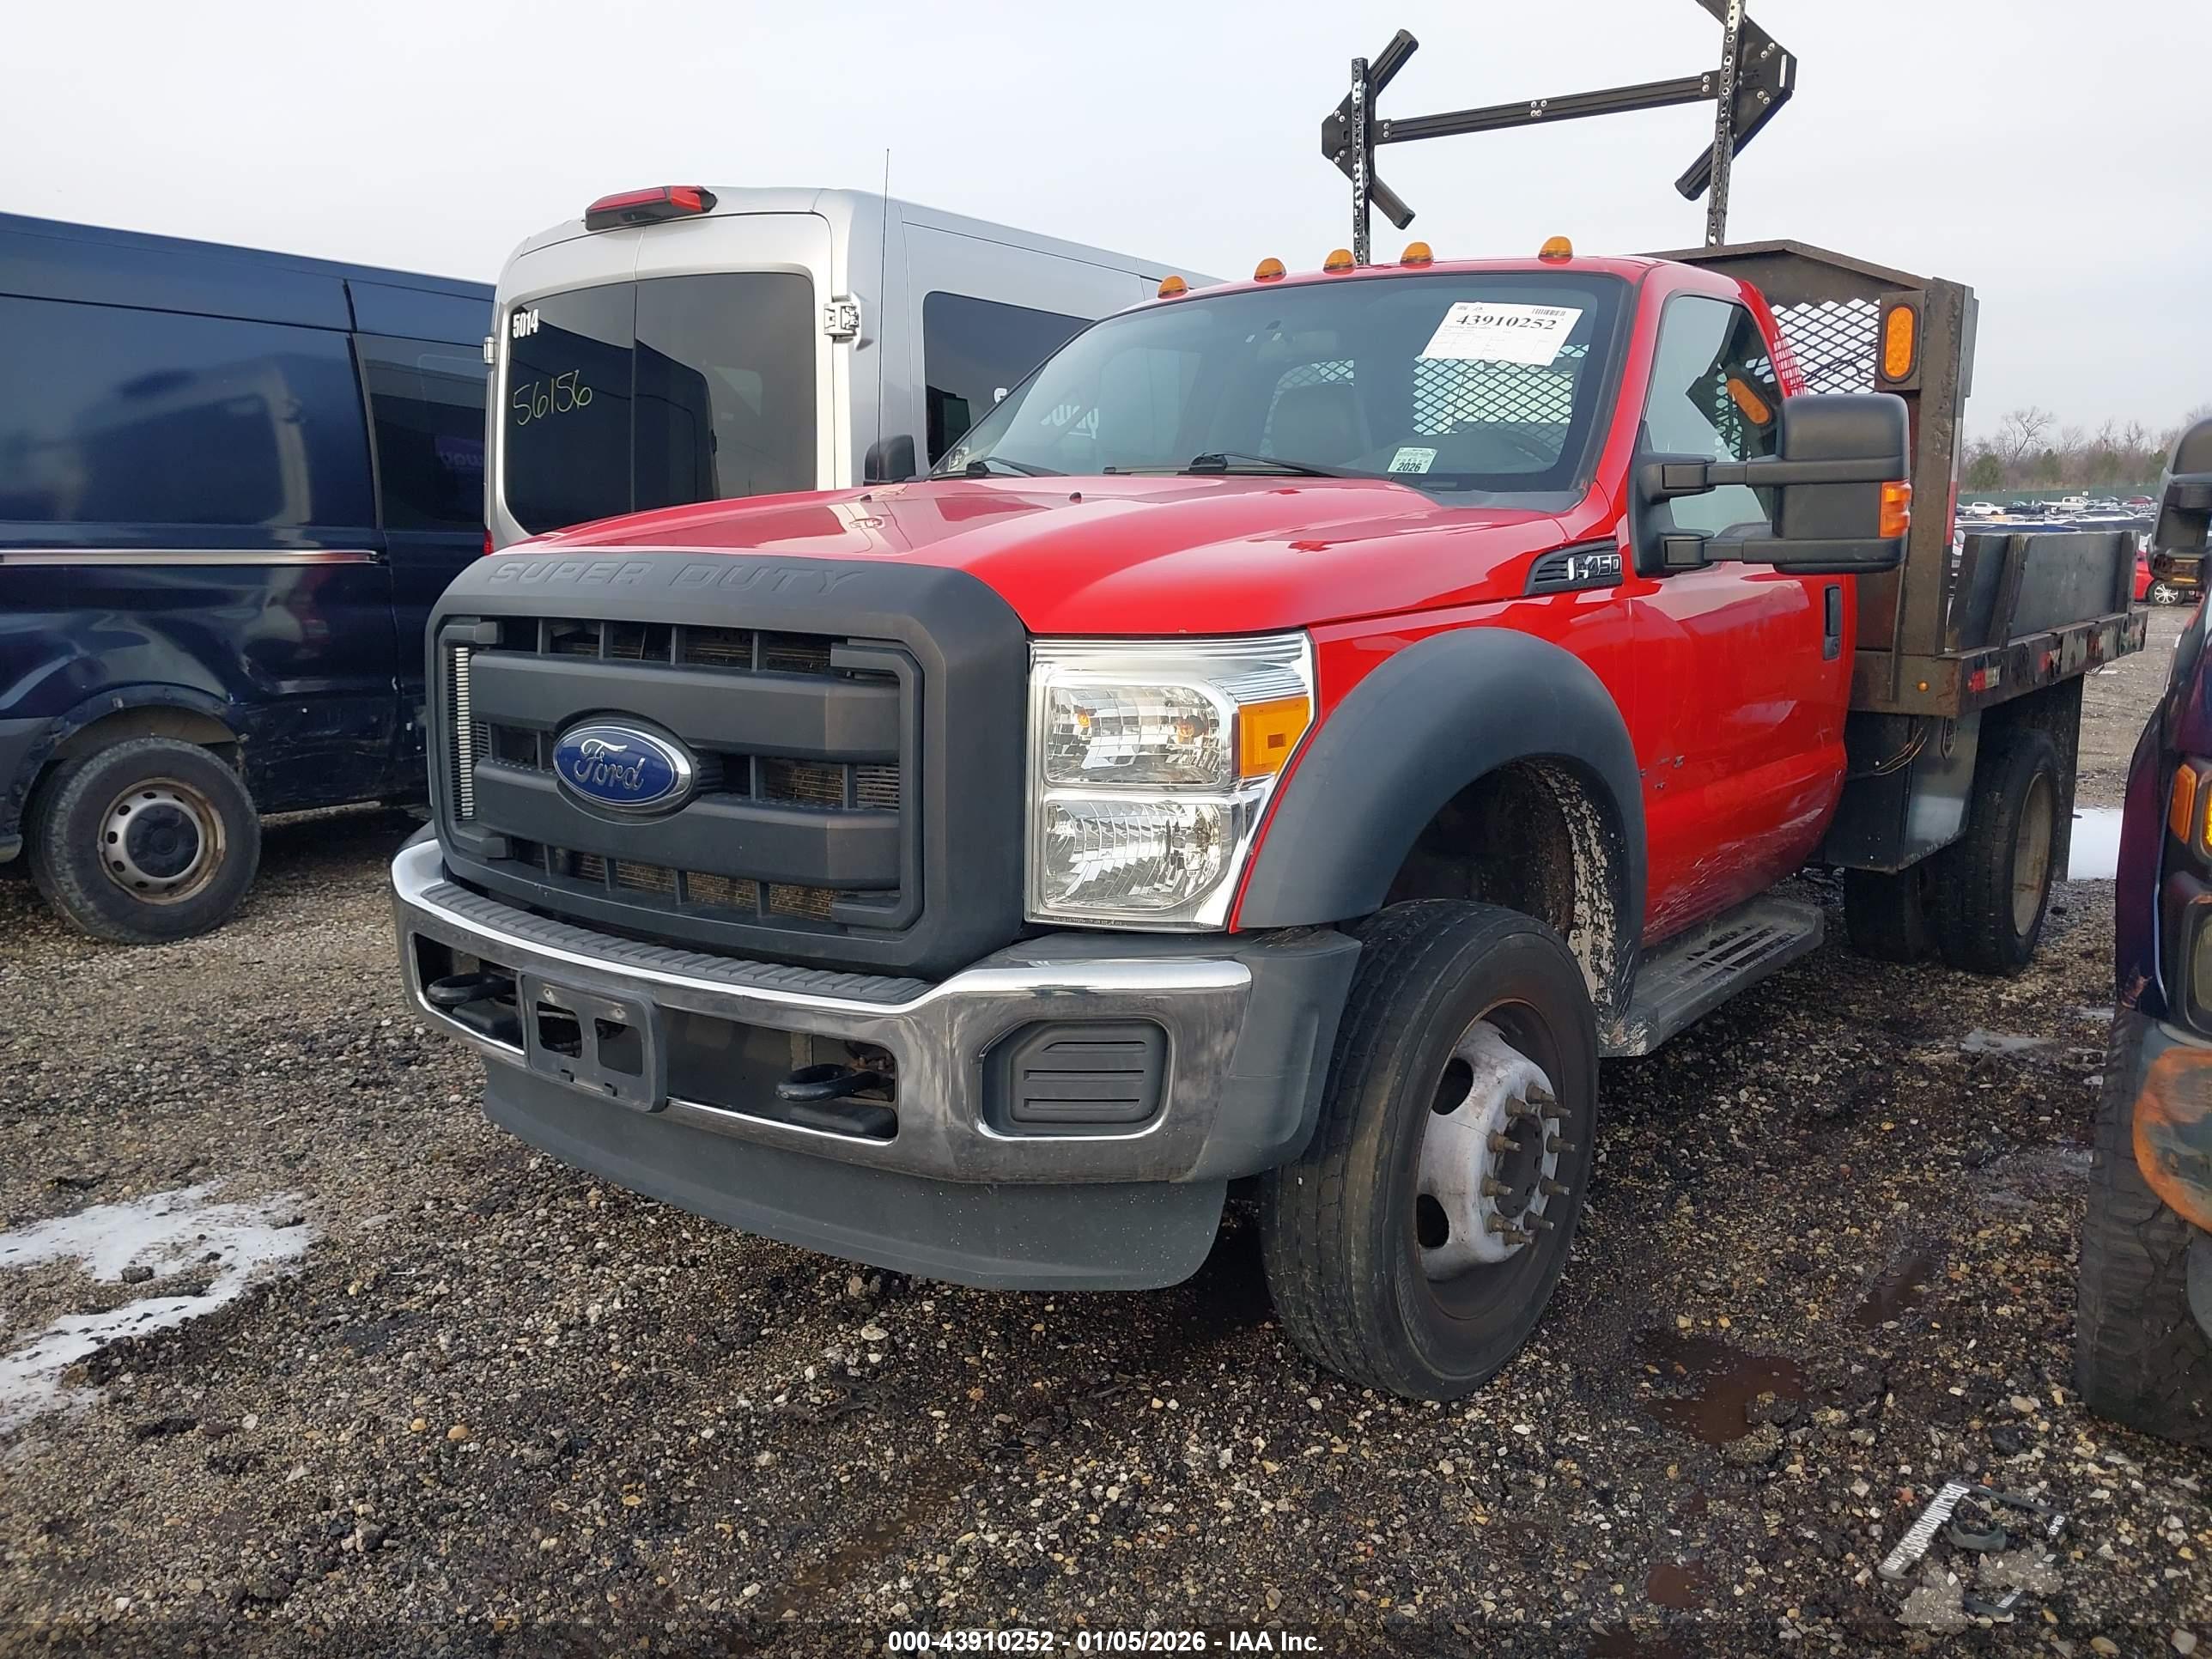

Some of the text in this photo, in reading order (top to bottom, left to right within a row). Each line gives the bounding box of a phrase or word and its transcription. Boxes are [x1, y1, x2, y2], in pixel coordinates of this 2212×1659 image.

[513, 308, 539, 339] 5014
[1456, 314, 1558, 331] 43910252
[513, 369, 592, 426] 56156
[1396, 462, 1422, 472] 2026
[488, 561, 865, 597] SUPER DUTY
[574, 738, 646, 791] Ford
